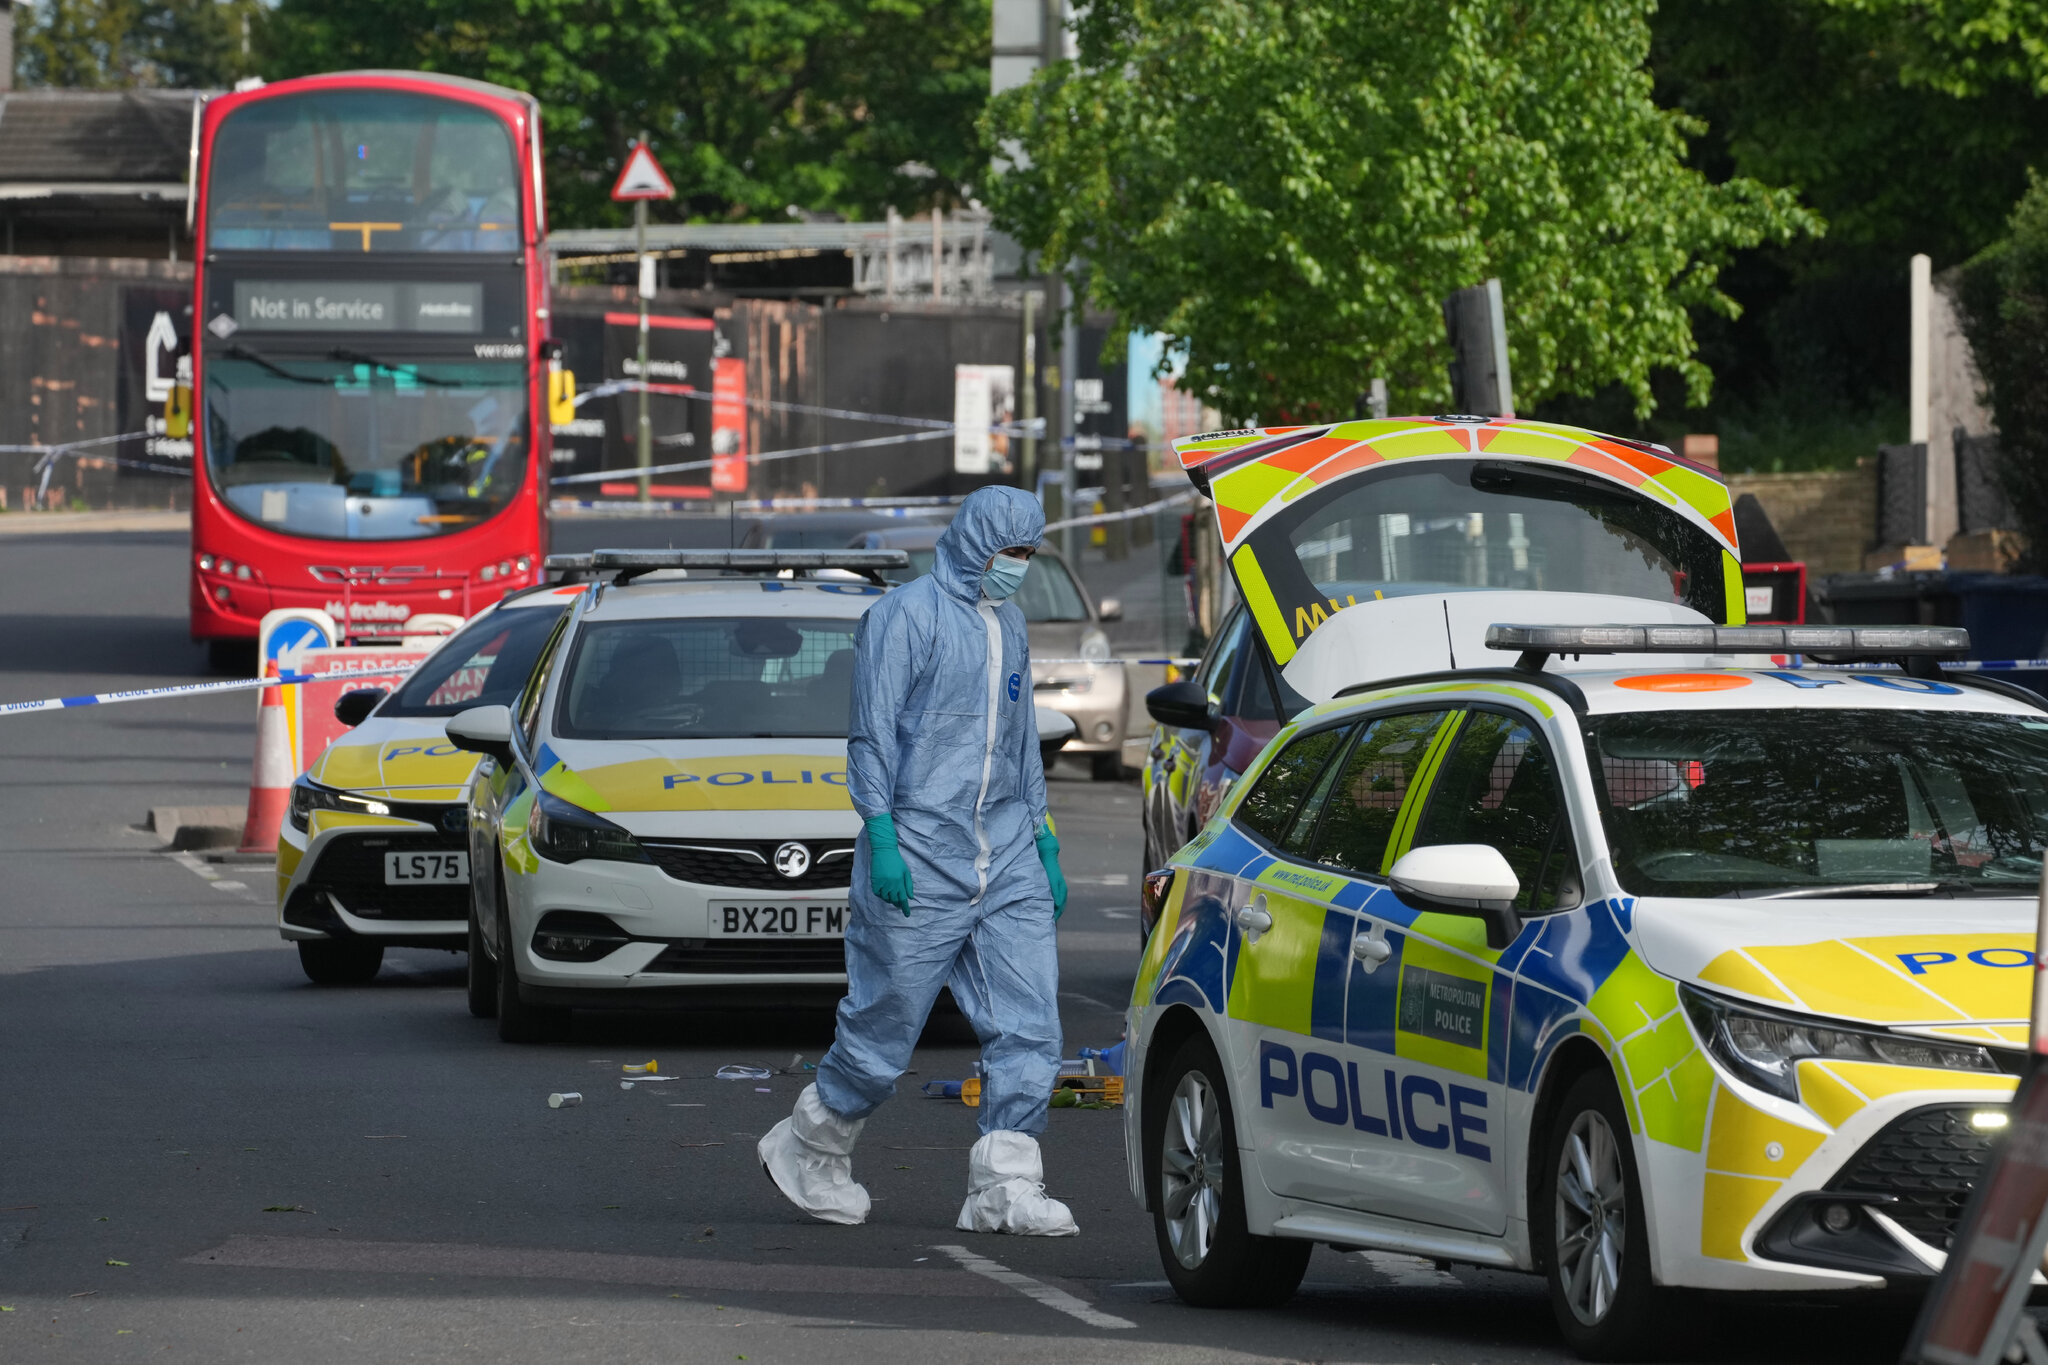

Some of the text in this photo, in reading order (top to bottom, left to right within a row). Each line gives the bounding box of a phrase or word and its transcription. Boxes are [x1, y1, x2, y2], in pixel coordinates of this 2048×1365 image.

[251, 297, 384, 320] Not in Service
[394, 855, 459, 880] LS75
[723, 907, 797, 933] BX20
[1429, 983, 1481, 1009] METROPOLITAN
[1435, 1009, 1472, 1034] POLICE
[1260, 1039, 1491, 1163] POLICE
